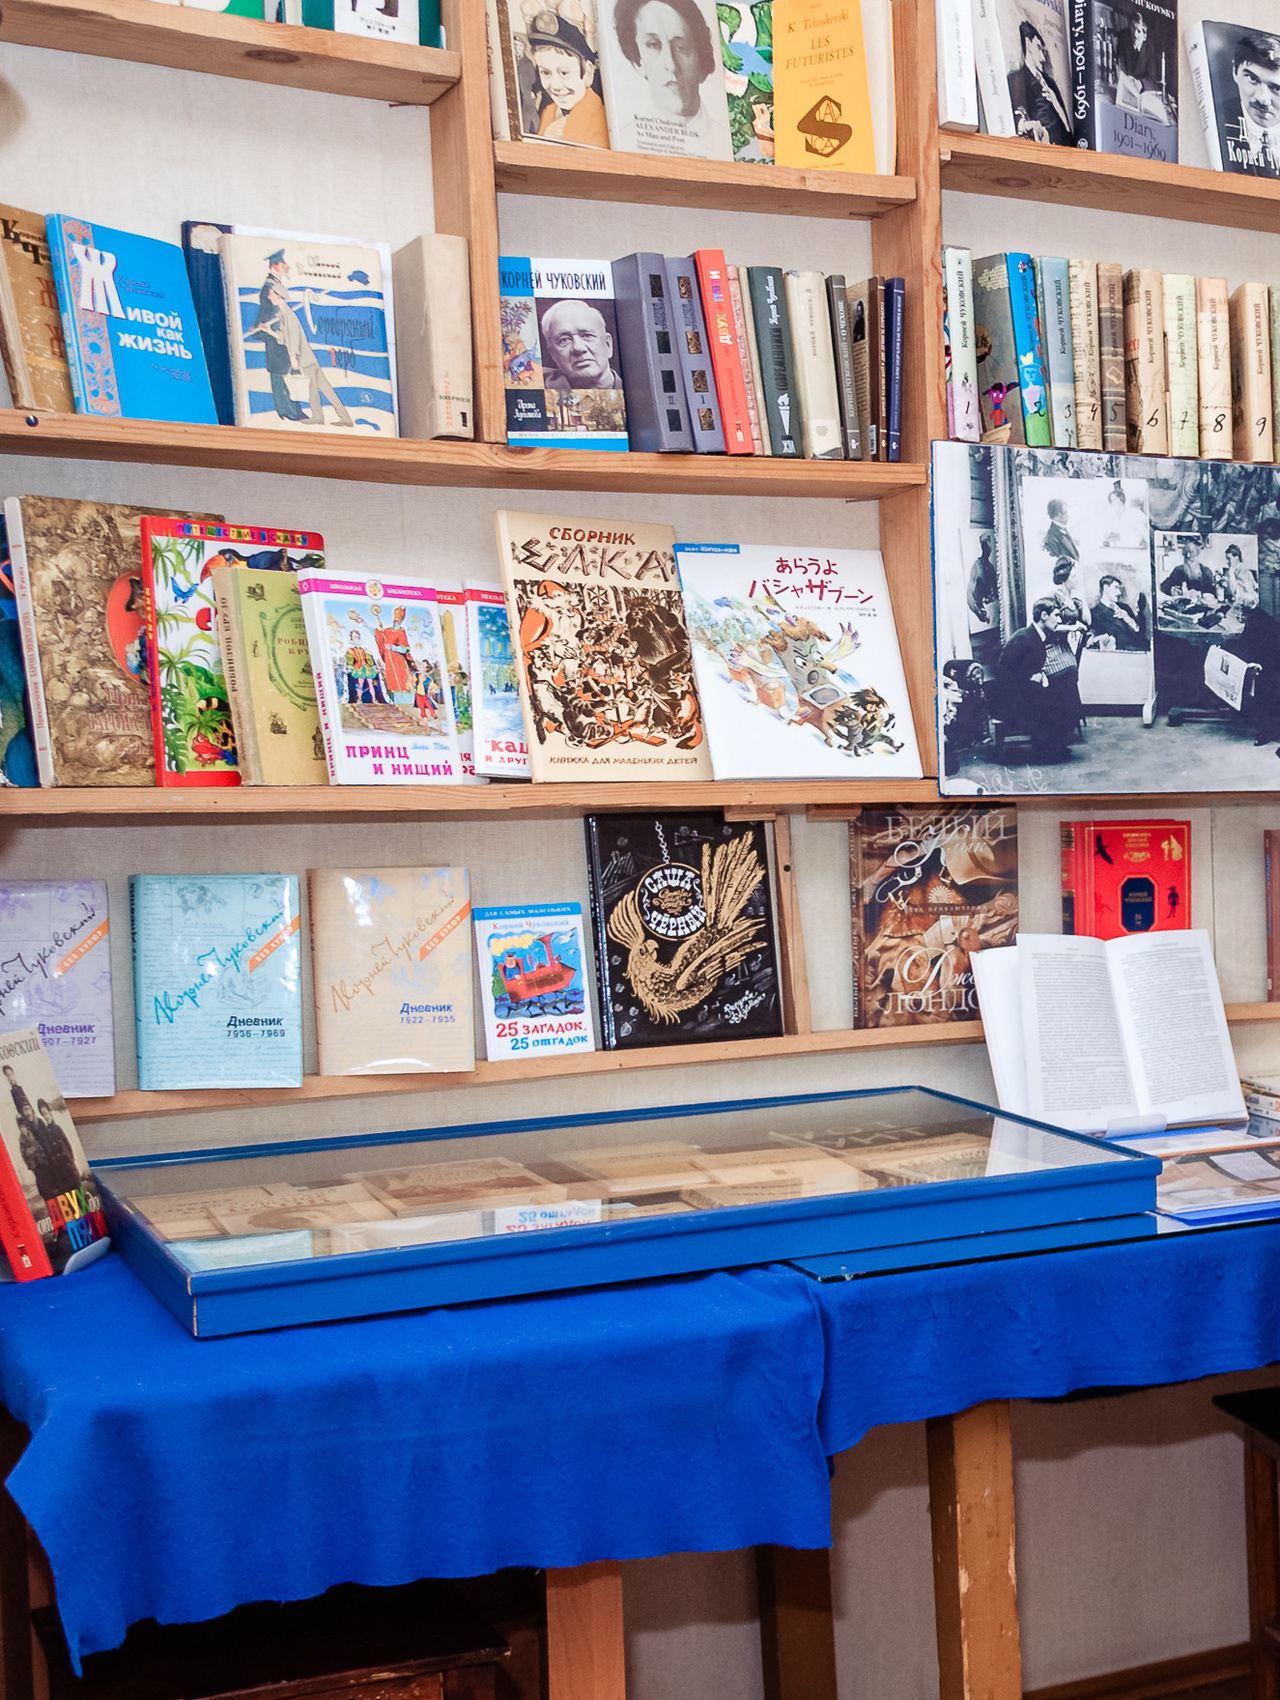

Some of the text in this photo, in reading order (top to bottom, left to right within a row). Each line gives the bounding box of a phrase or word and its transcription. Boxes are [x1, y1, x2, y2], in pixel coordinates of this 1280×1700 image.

[811, 36, 831, 50] LES
[786, 45, 855, 69] FUTURISTES
[1124, 113, 1157, 141] Diary,
[501, 269, 607, 291] КОРНЕЙ ЧУКОВСКИЙ
[156, 328, 185, 344] как
[769, 328, 788, 392] СОВРЕМЕННИКИ
[964, 401, 971, 415] 1
[1064, 404, 1072, 419] 3
[1090, 402, 1098, 421] 4
[1109, 402, 1124, 422] 5
[1146, 409, 1159, 428] 6
[1181, 411, 1189, 430] 7
[1213, 414, 1226, 432] 8
[1256, 417, 1267, 436] 9
[177, 523, 308, 546] ПУТЕШЕСТВИЕ В СКАЗКУ
[549, 527, 636, 546] СБОРНИК
[775, 557, 839, 576] あらうよ
[748, 579, 874, 605] バシャザブーン
[219, 597, 238, 693] РОБИНЗОН КРУЗО
[288, 647, 310, 656] КРУ
[345, 745, 410, 761] ПРИНЦ
[498, 756, 528, 765] ДРУГ
[549, 756, 698, 765] КНИЖКА ДЛЯ МАЛЕНЬКИХ ДЕТЕЙ
[373, 763, 384, 776] И
[391, 760, 454, 776] НИЩИЙ
[644, 868, 696, 894] САША
[492, 920, 570, 931] Корней Чуковский
[648, 904, 707, 937] ЧЁРНЫЙ
[425, 915, 462, 952] БЕЗ КУПЮР
[63, 953, 79, 968] БЕЗ
[254, 947, 271, 963] БЕЗ
[331, 889, 455, 1013] Корней Чуковский
[895, 944, 975, 1002] Дже
[399, 1003, 453, 1016] Дневник
[883, 988, 981, 1016] ЛОНДО
[37, 1022, 96, 1037] Дневник
[226, 1015, 284, 1029] Дневник
[495, 1021, 519, 1038] 25
[0, 1031, 41, 1061] ОВСКИЙ
[510, 1037, 530, 1051] 25
[47, 1186, 90, 1235] ДВУХ
